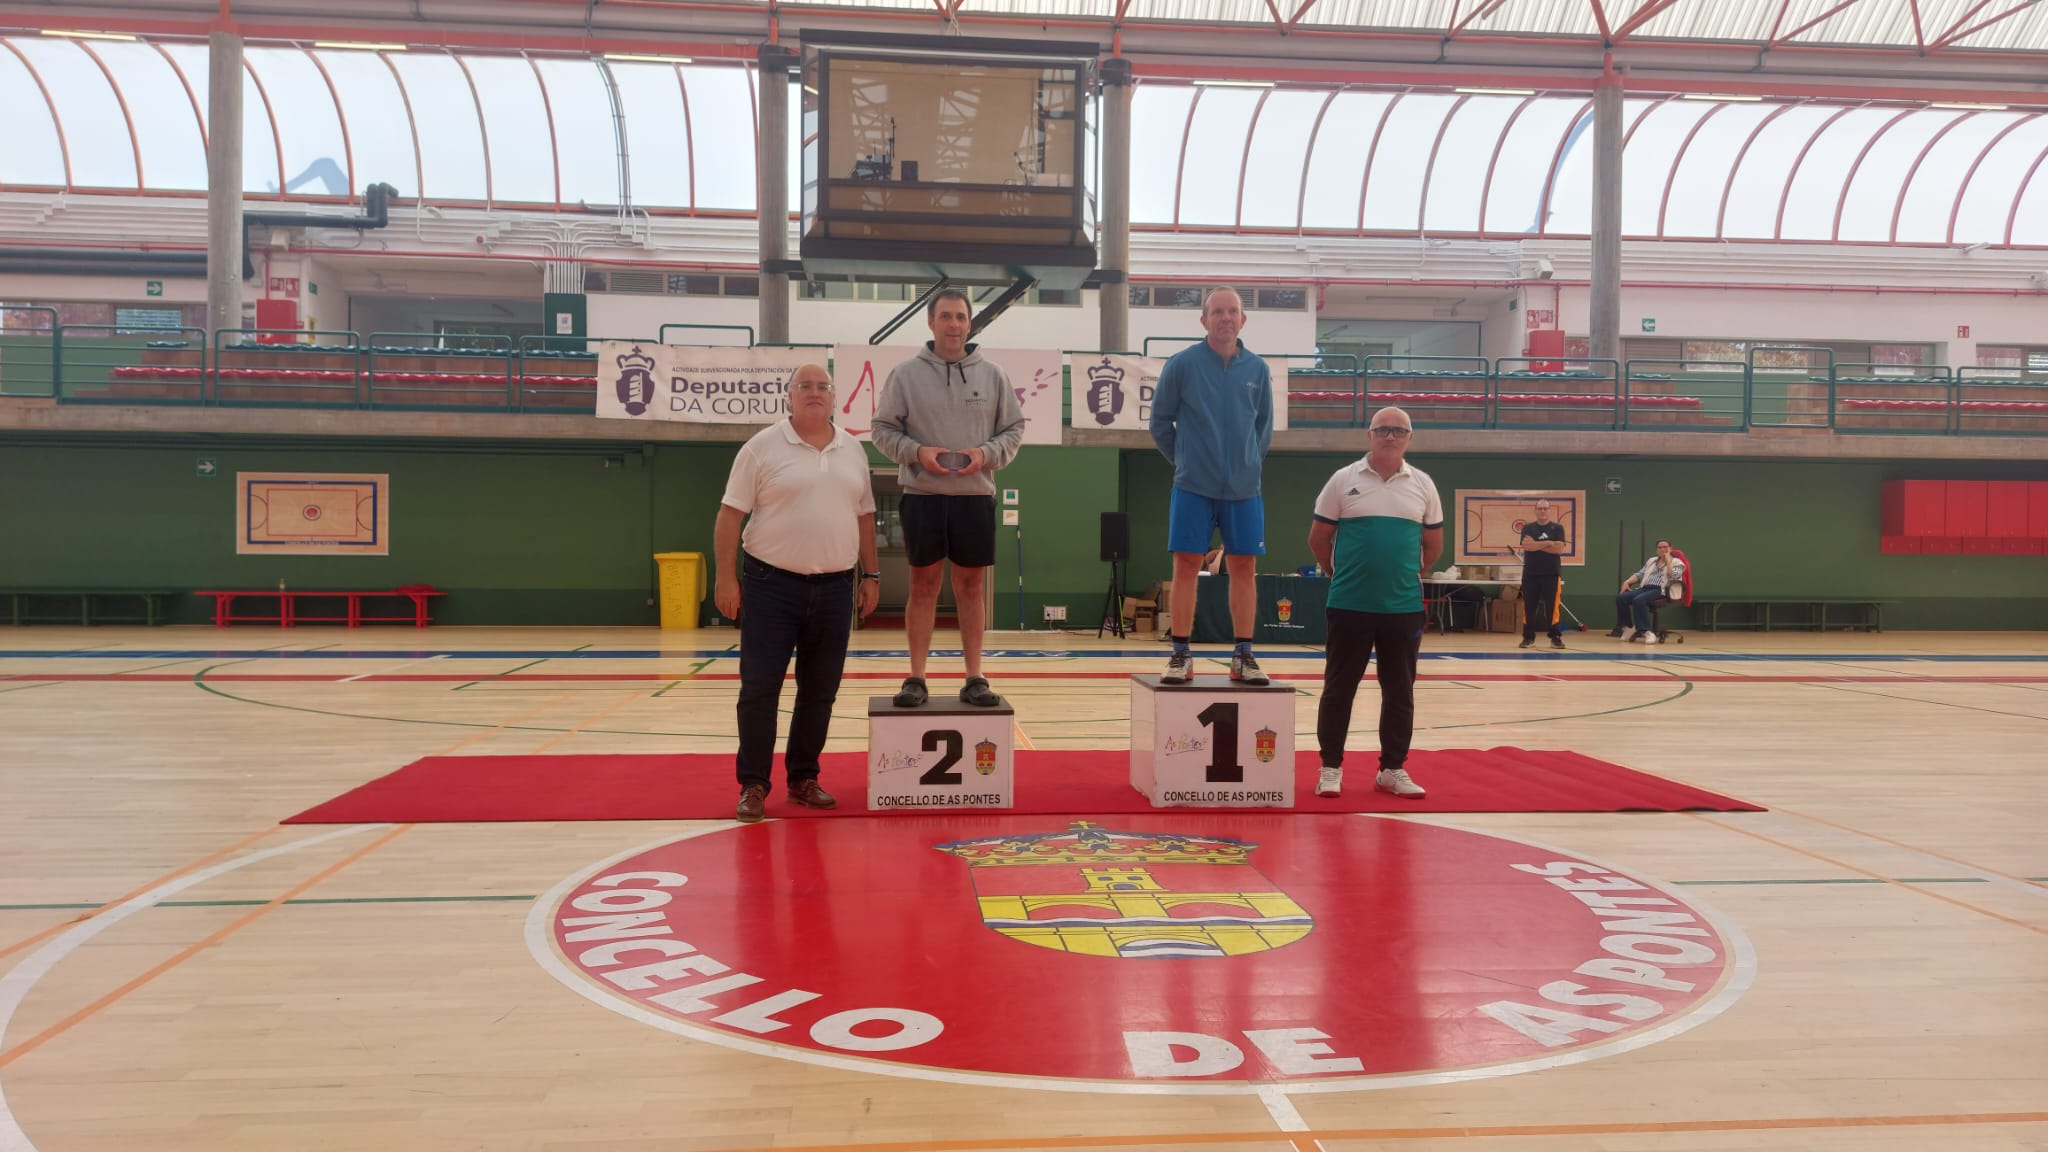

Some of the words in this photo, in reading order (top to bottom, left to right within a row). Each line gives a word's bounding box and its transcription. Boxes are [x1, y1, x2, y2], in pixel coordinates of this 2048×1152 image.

[671, 377, 790, 398] Deputaci
[670, 396, 703, 414] DA
[712, 395, 789, 415] CORU
[1196, 702, 1244, 782] 1
[919, 729, 963, 785] 2
[877, 795, 929, 806] CONCELLO
[932, 795, 945, 805] DE
[946, 794, 960, 805] AS
[963, 794, 1001, 805] PONTES
[1163, 791, 1215, 801] CONCELLO
[1217, 791, 1229, 801] DE
[1231, 791, 1245, 801] AS
[1246, 791, 1284, 801] PONTES
[560, 871, 945, 1051] CONCELLO
[1122, 1027, 1365, 1078] DE
